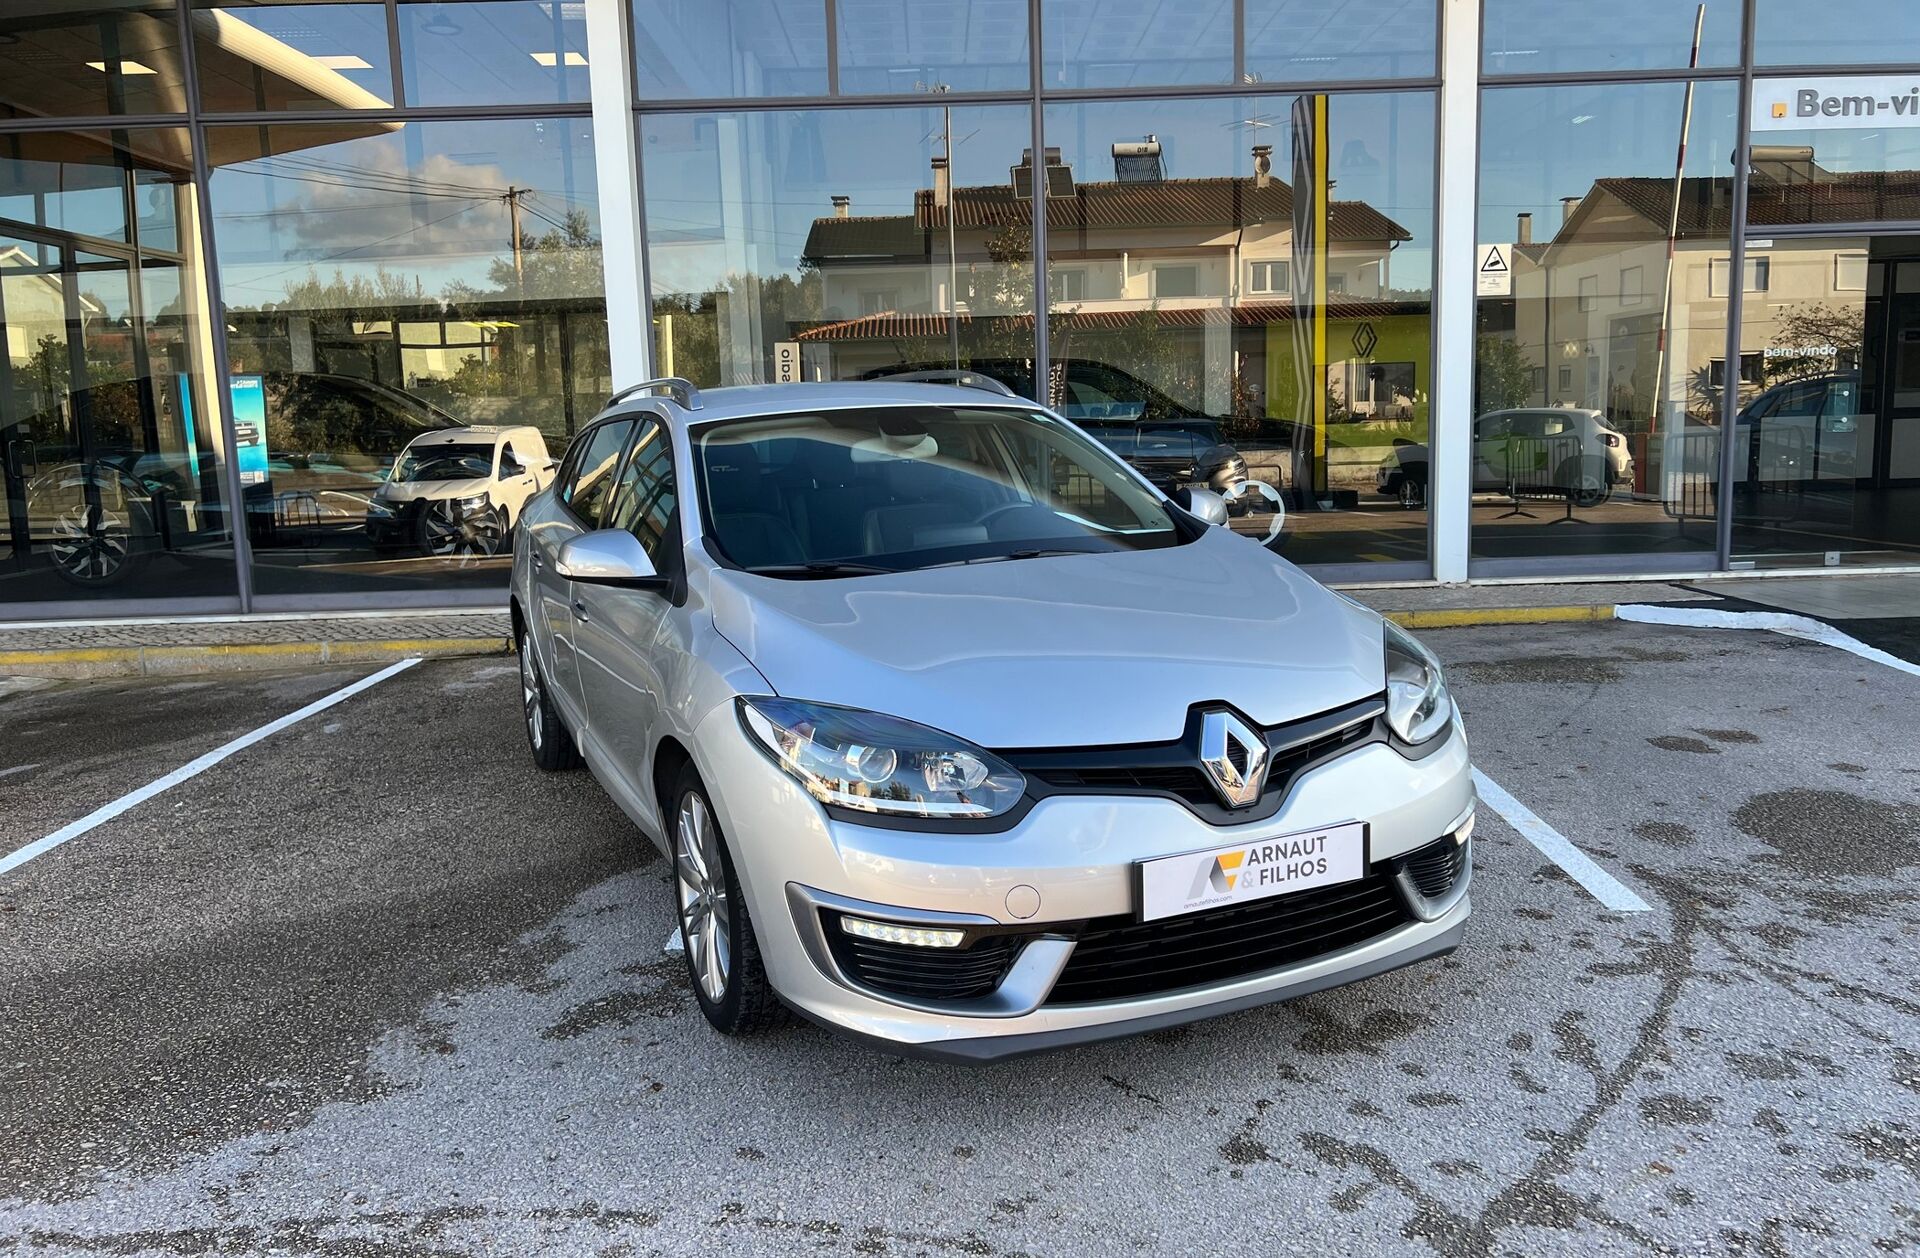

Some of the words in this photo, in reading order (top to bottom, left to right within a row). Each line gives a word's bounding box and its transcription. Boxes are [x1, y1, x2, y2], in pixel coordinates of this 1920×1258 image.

[1797, 87, 1919, 117] Bem-vi
[1763, 344, 1837, 356] bem-vindo
[1247, 835, 1327, 866] ARNAUT
[1241, 872, 1254, 889] &
[1260, 857, 1327, 885] FILHOS
